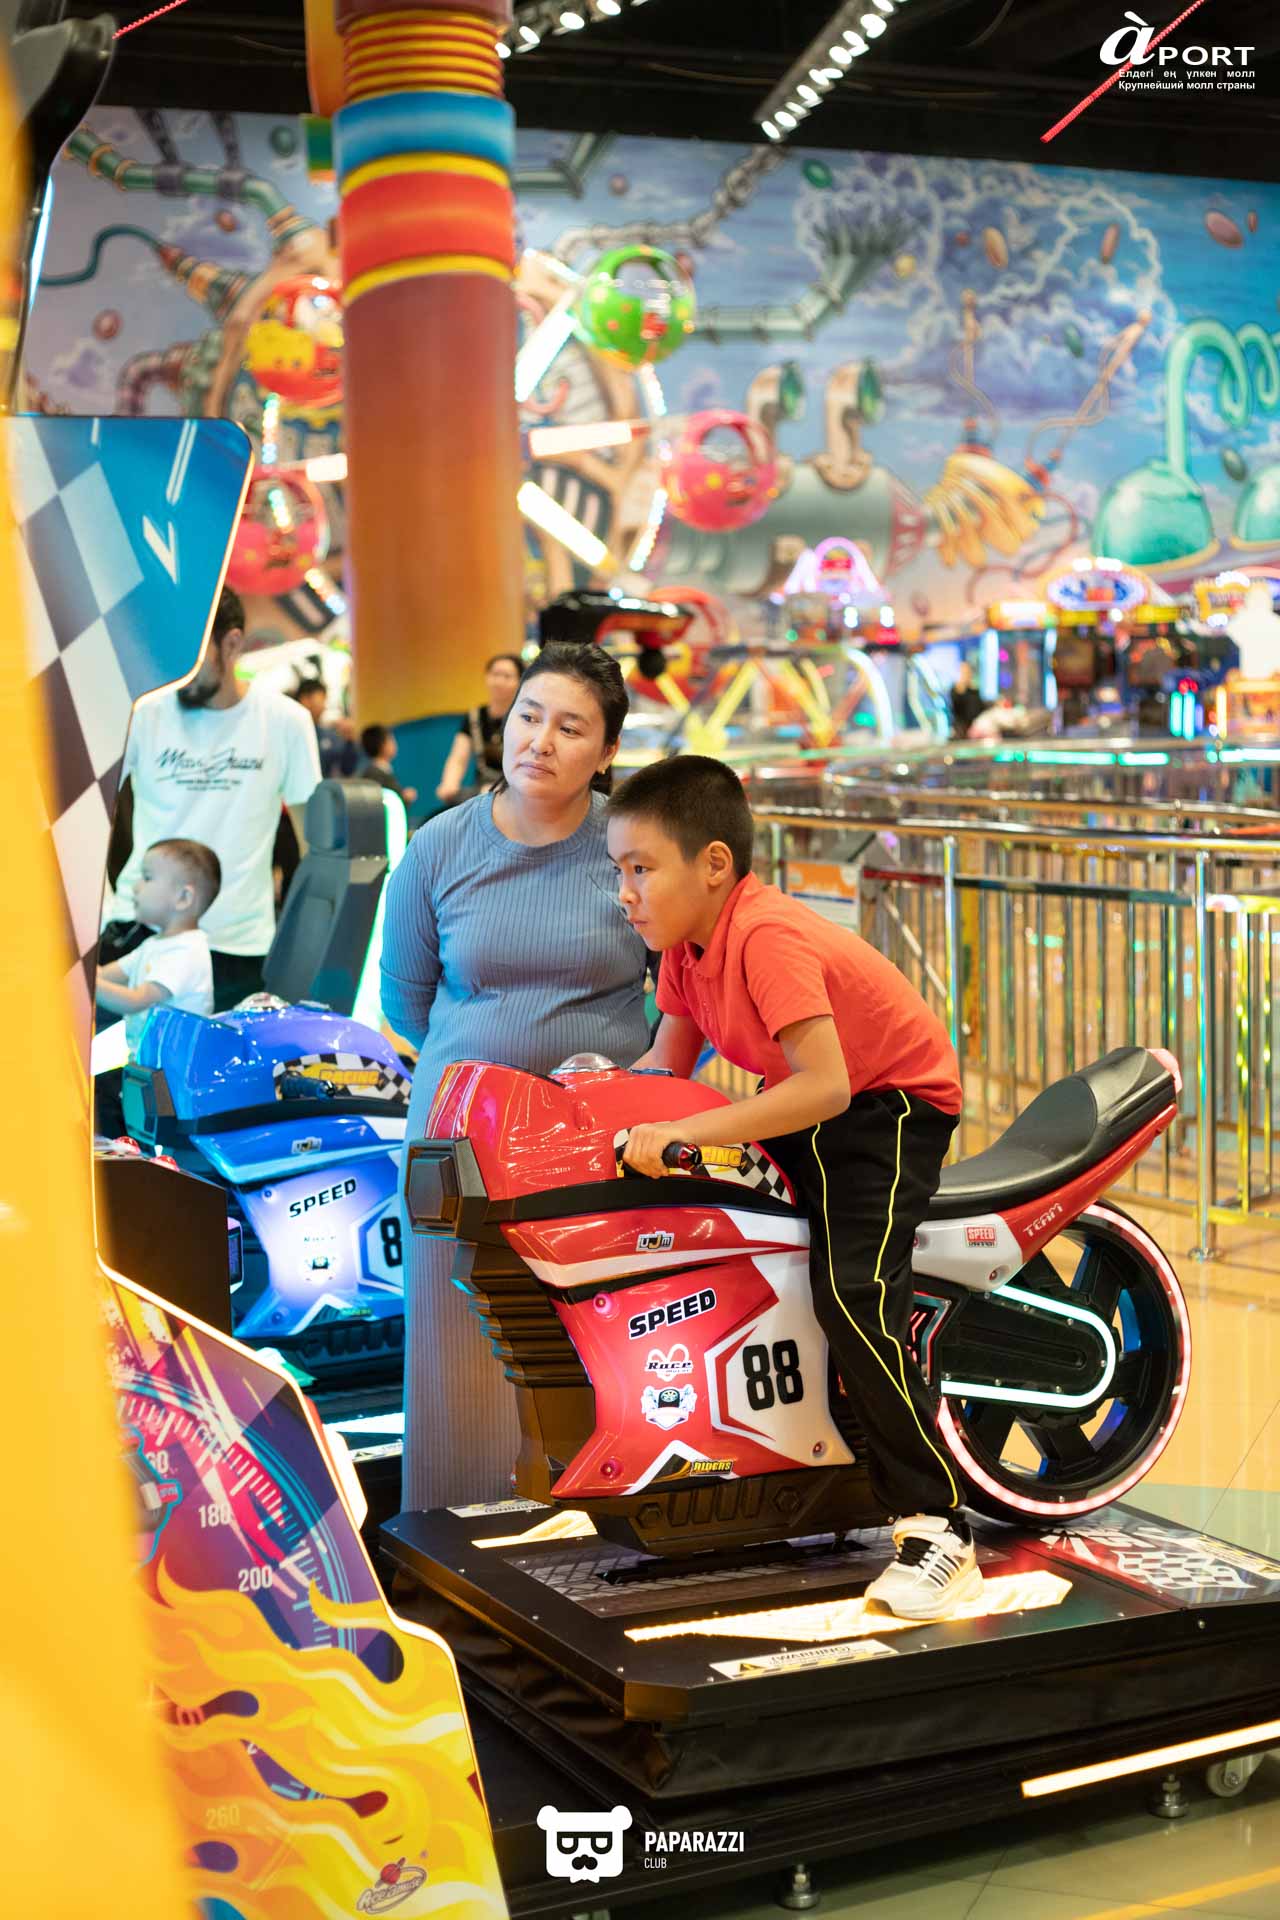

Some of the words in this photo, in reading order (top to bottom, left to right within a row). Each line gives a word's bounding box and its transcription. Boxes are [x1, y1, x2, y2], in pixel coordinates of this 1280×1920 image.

[289, 1178, 357, 1217] SPEED
[967, 1228, 995, 1240] SPEED
[629, 1289, 717, 1338] SPEED
[648, 1362, 692, 1370] Race
[743, 1339, 804, 1411] 88
[198, 1503, 231, 1529] 180
[238, 1565, 273, 1592] 200
